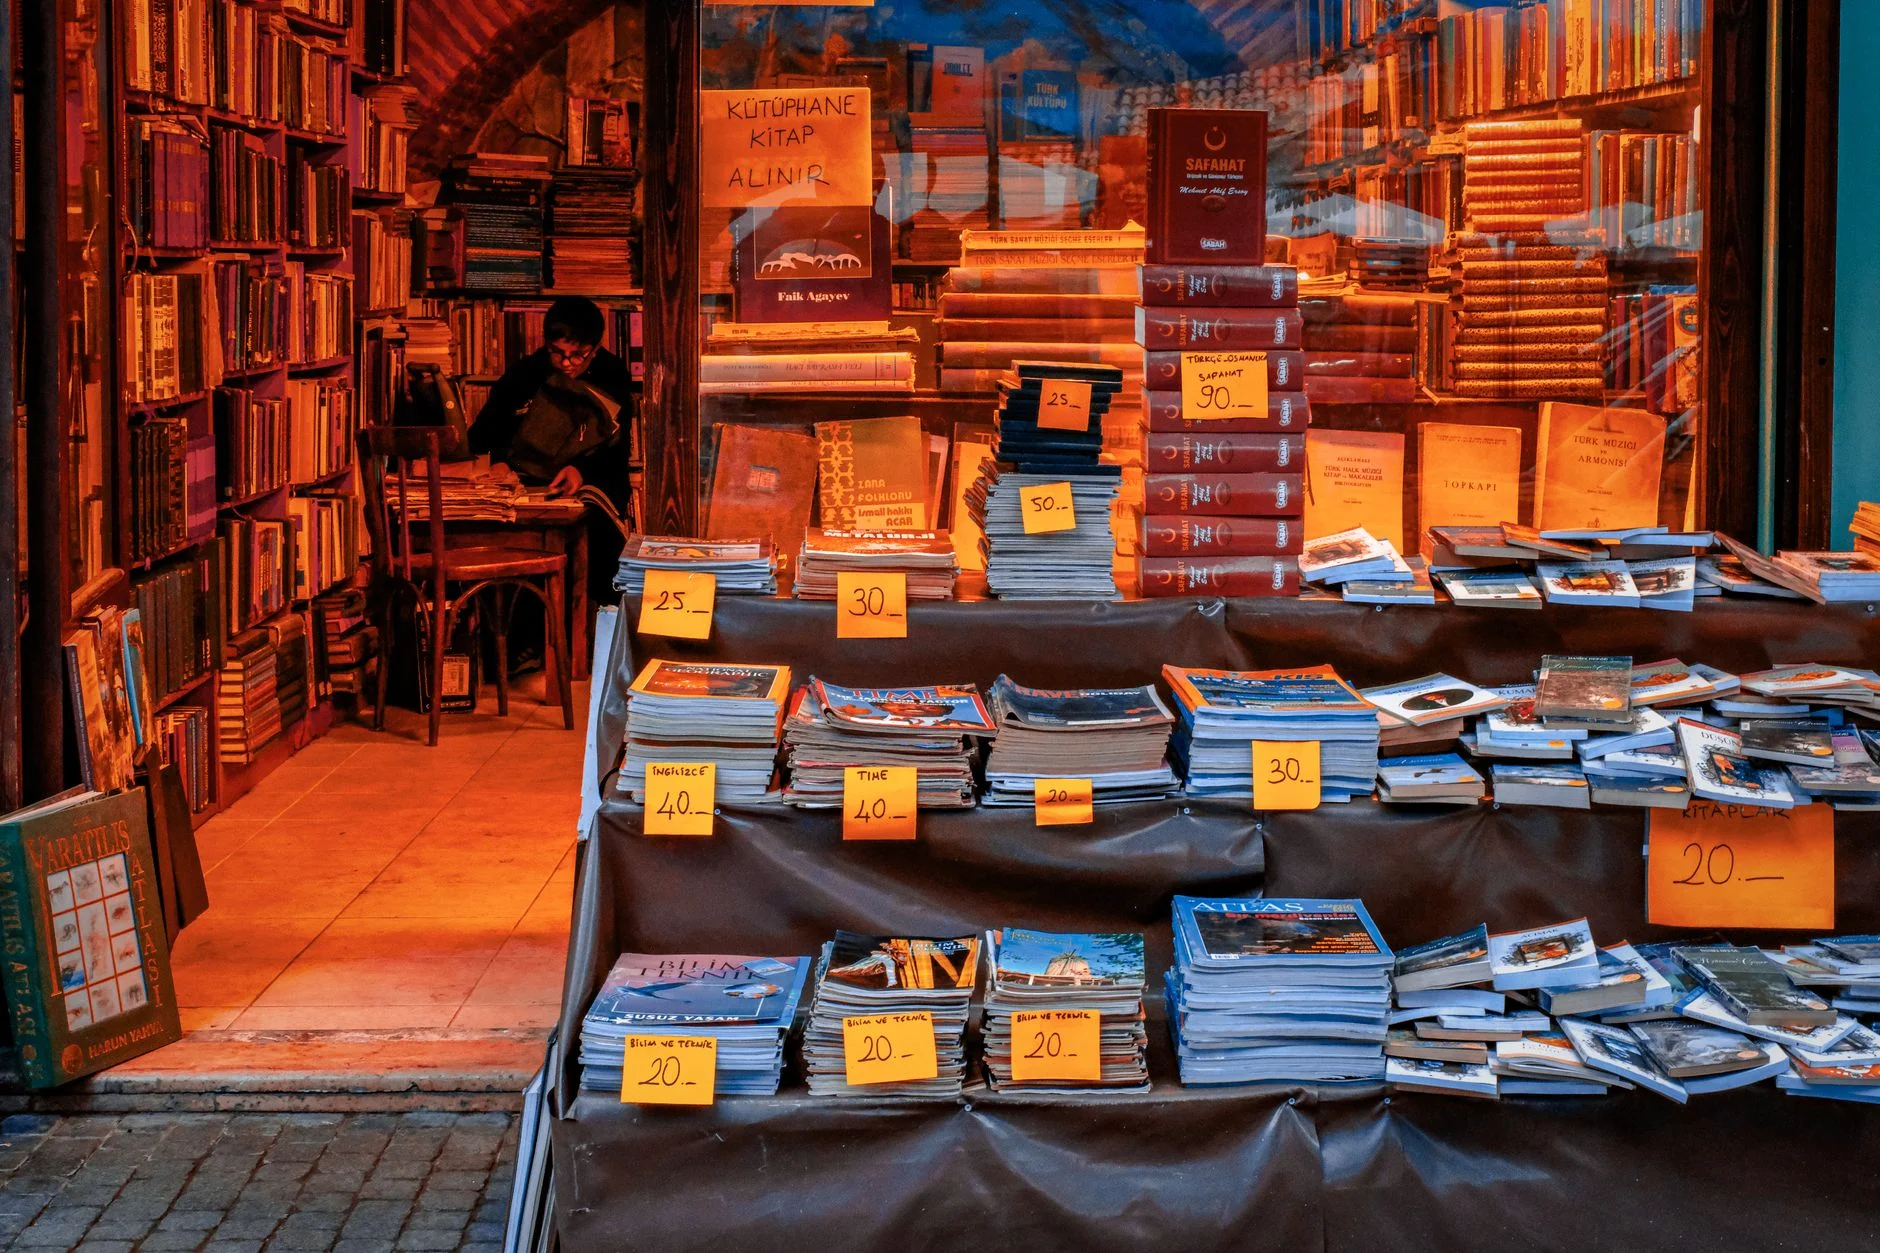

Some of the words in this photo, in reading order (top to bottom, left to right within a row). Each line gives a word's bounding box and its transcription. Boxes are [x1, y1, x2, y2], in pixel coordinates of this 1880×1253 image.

[727, 95, 857, 119] KÜTÜPHANE
[750, 125, 814, 149] KİTAP
[1186, 158, 1246, 172] SAFAHAT
[728, 164, 830, 188] ALINIR
[1179, 186, 1207, 194] Mehmet
[1209, 187, 1226, 196] Akif
[1228, 187, 1248, 196] Ersoy
[1201, 238, 1226, 249] SABAH
[778, 291, 804, 302] Faik
[806, 292, 850, 302] Agayev
[1444, 480, 1497, 492] TOPKAPI
[856, 770, 889, 781] TIME
[1193, 902, 1304, 913] ATLAS
[624, 1013, 678, 1022] SUSUZ
[88, 1034, 128, 1059] HARUN
[130, 1021, 164, 1043] YAHYA
[630, 1038, 656, 1048] BİLİM
[661, 1039, 674, 1048] VE
